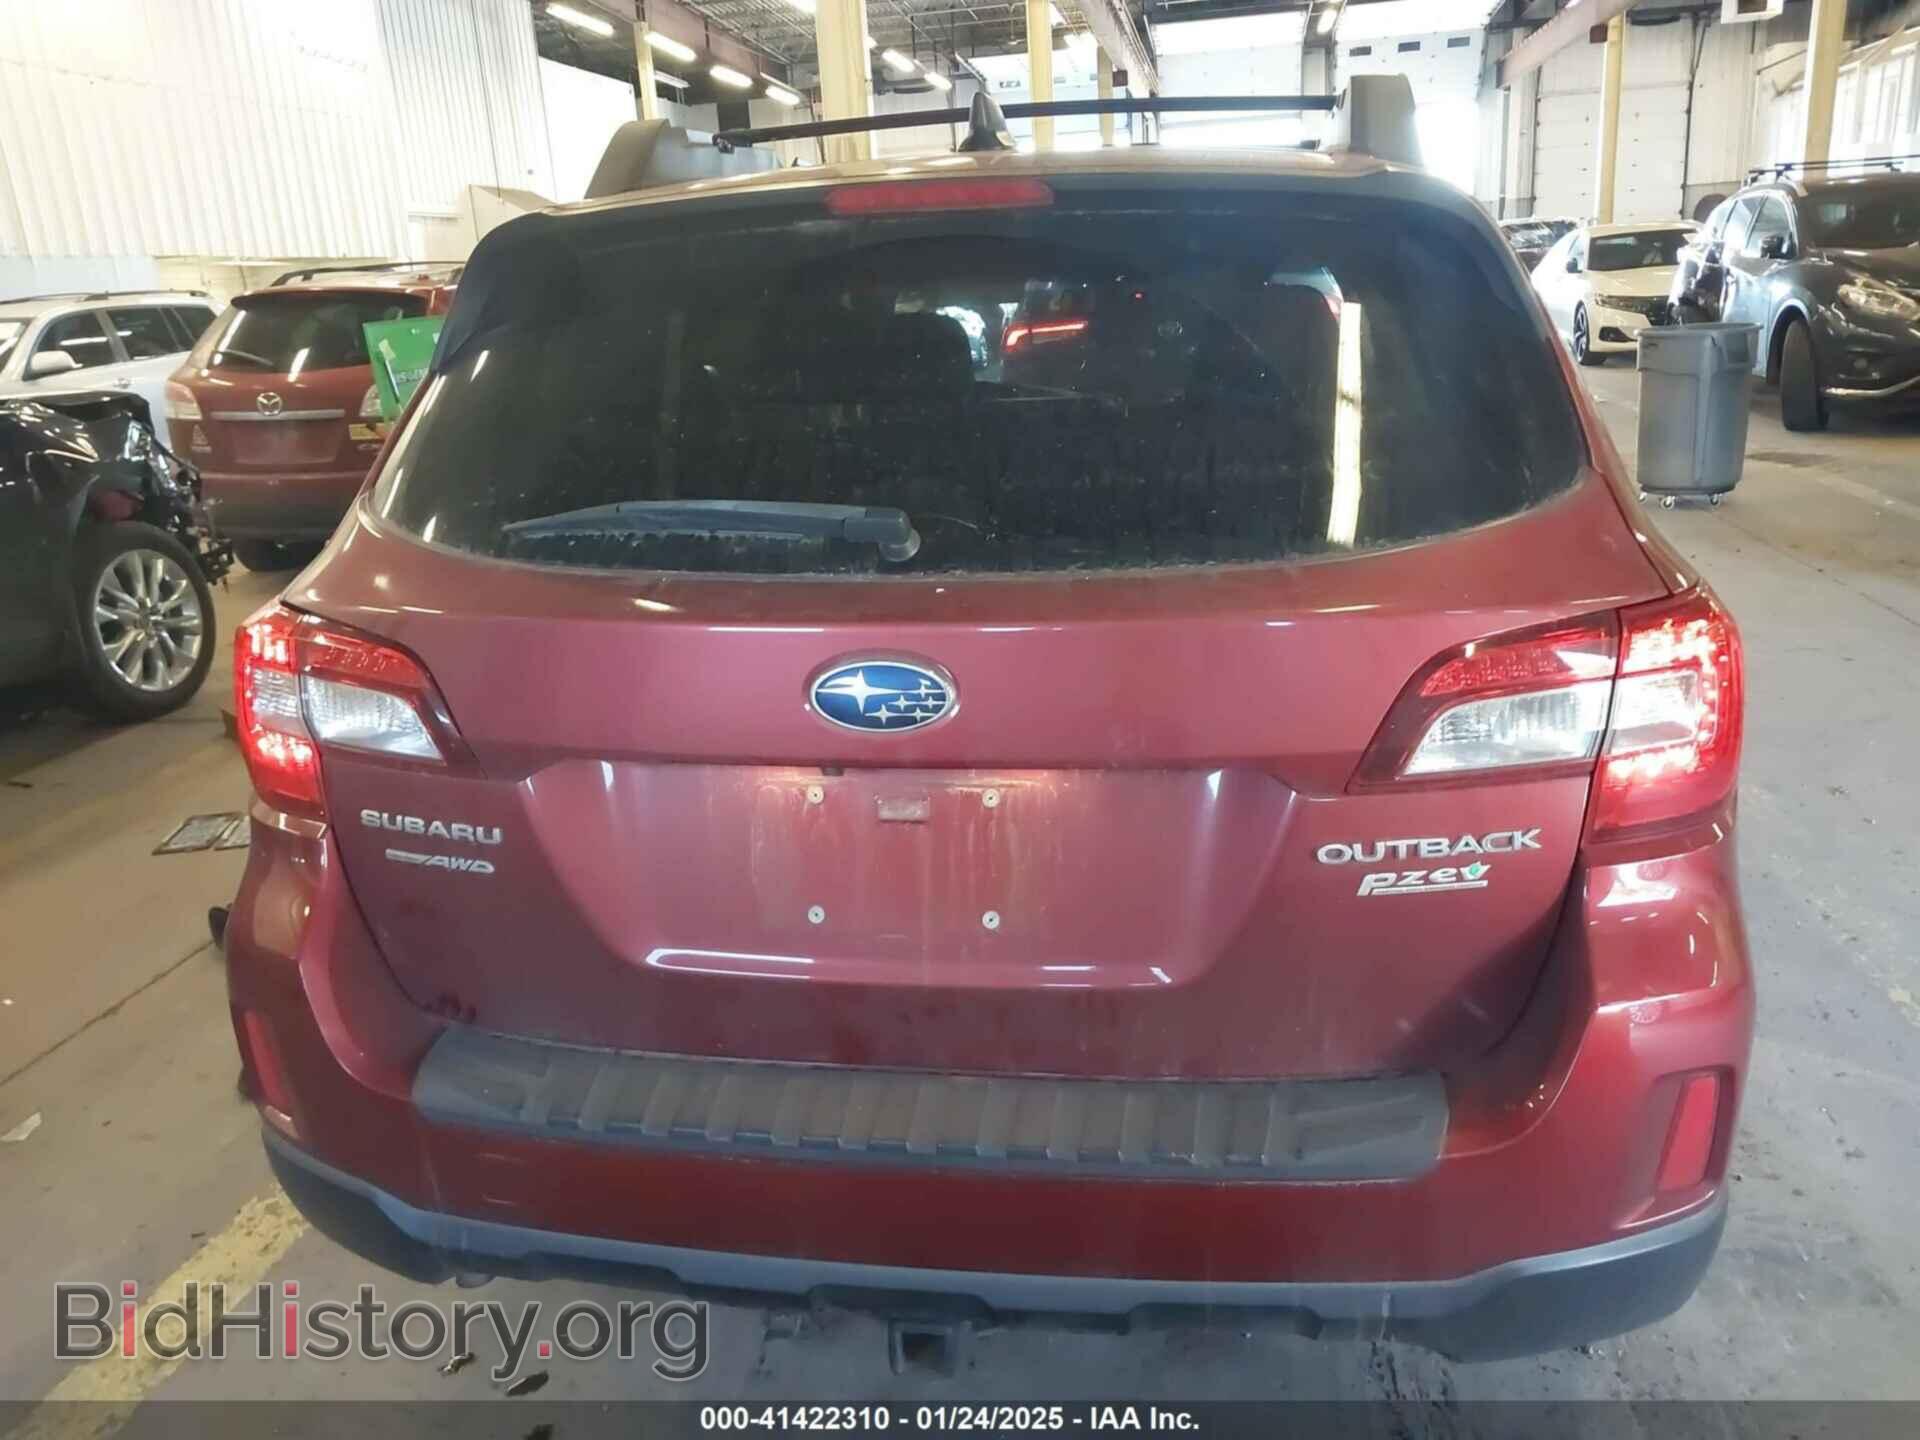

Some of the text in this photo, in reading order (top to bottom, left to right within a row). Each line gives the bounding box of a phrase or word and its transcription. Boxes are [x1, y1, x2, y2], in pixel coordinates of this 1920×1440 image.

[360, 808, 502, 845] SUBARU
[425, 855, 496, 874] AWD
[1316, 828, 1542, 865] OUTBACK
